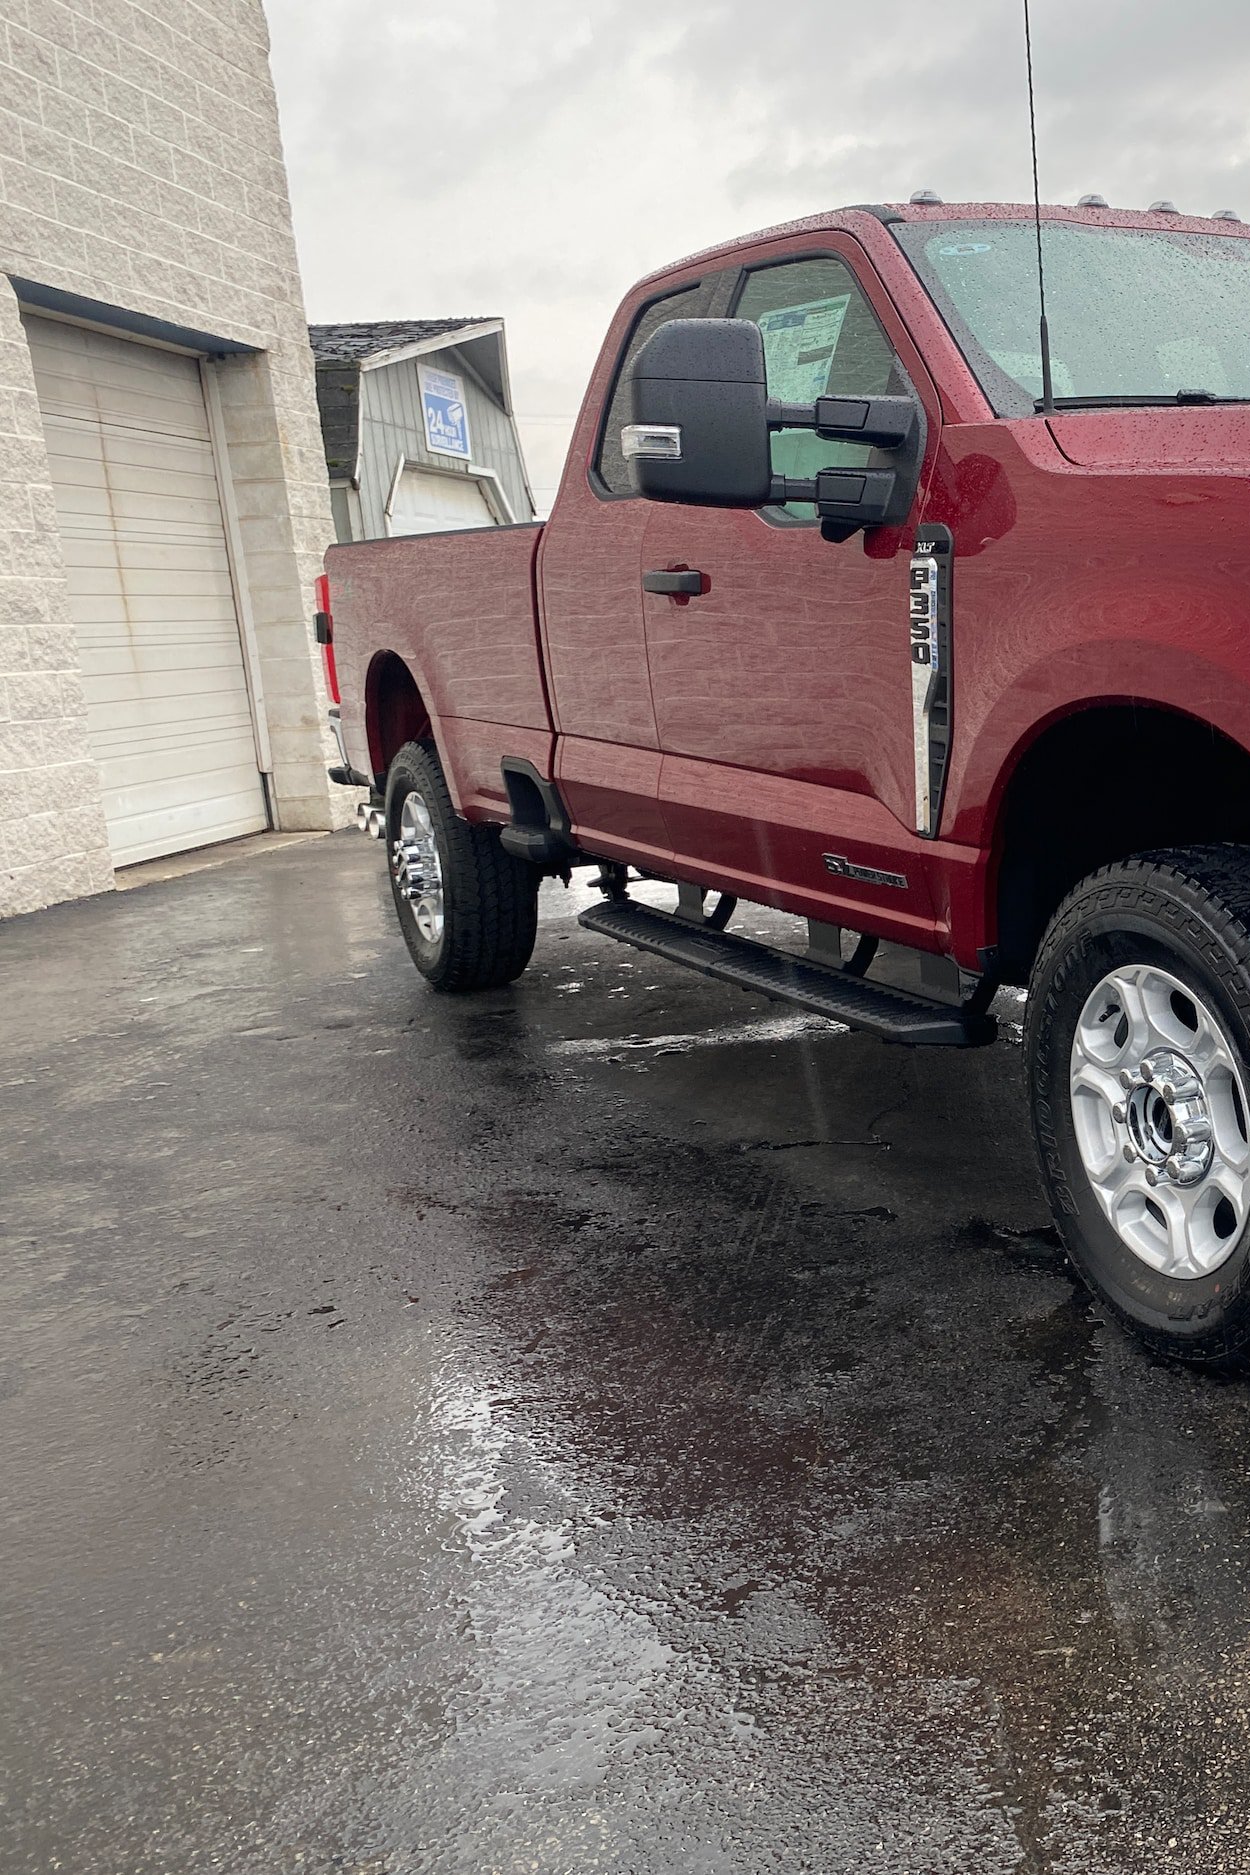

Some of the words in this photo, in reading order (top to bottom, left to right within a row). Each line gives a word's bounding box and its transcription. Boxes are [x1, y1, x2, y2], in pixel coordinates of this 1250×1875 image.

[428, 407, 445, 435] 24
[915, 541, 936, 554] XLT
[910, 567, 930, 665] F350
